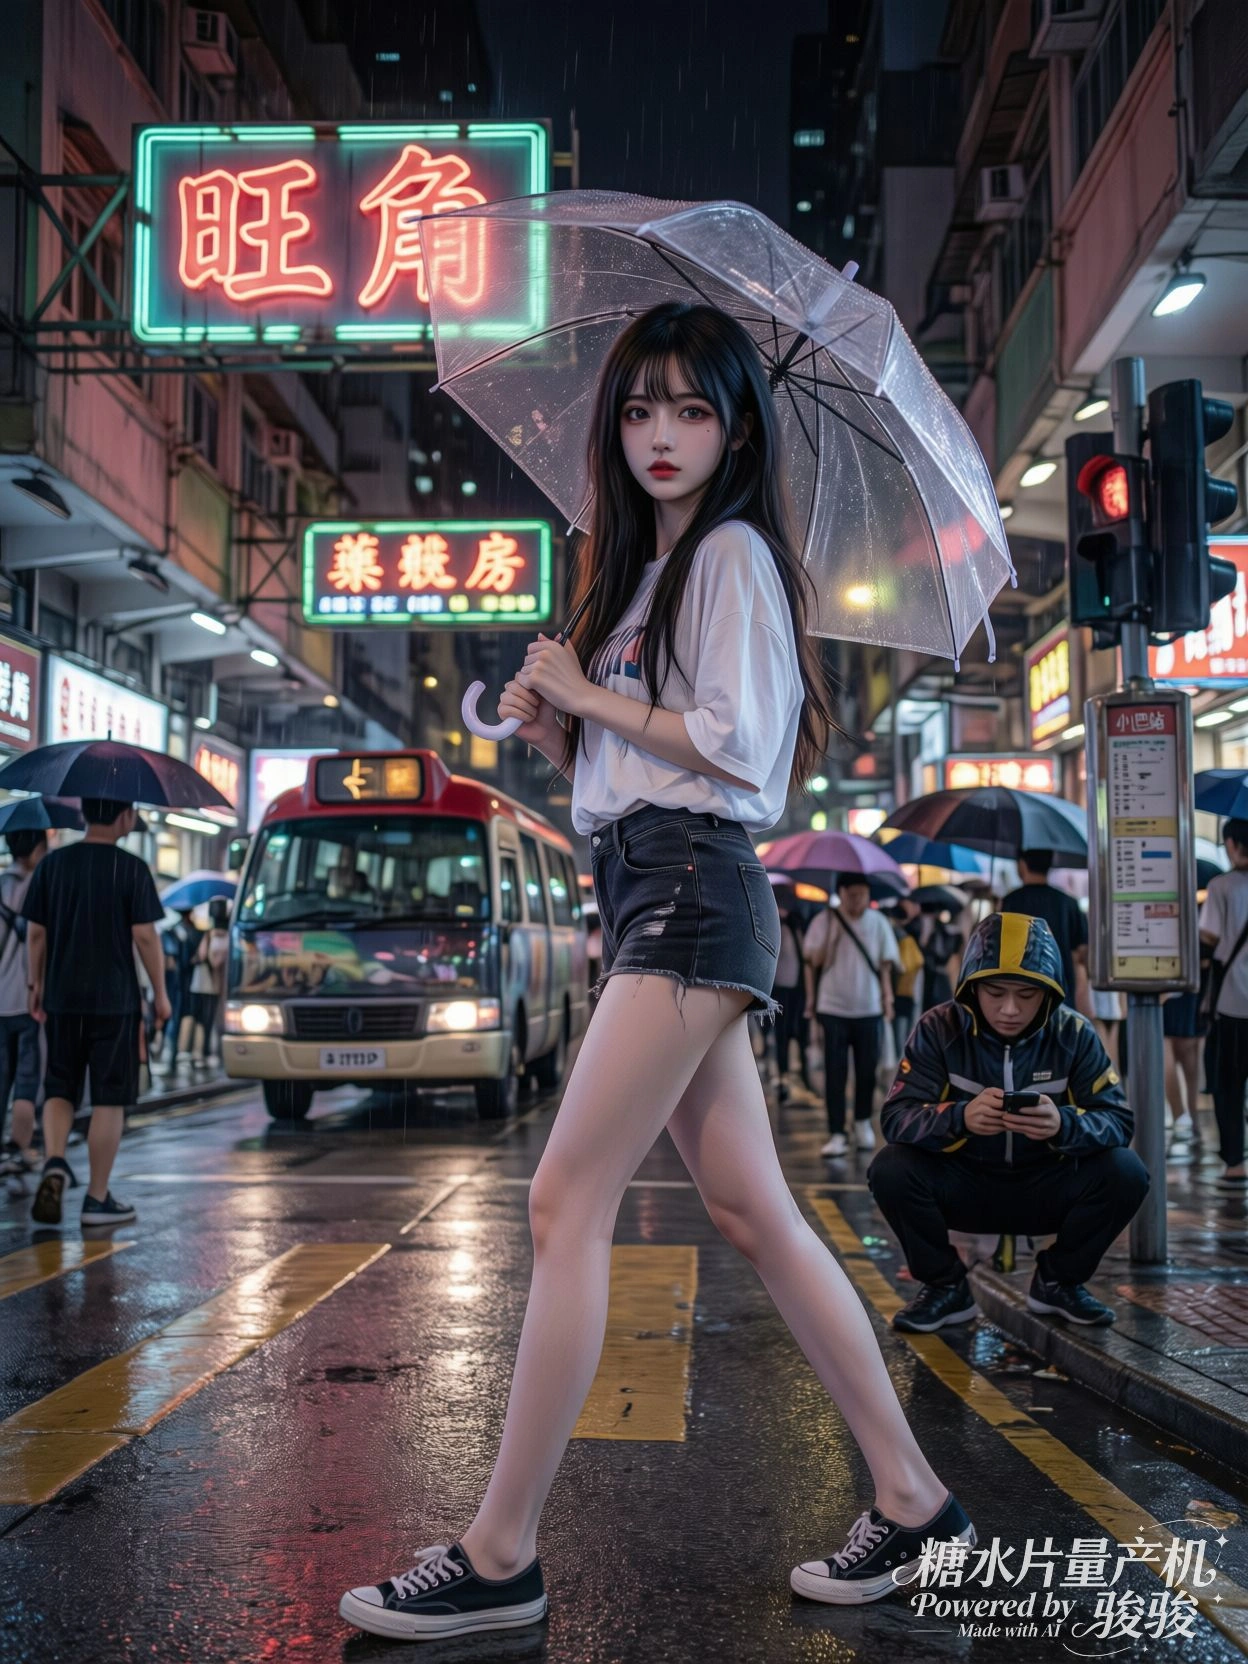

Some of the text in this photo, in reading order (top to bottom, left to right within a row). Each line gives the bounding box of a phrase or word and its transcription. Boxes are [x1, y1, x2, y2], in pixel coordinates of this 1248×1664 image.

[178, 145, 488, 308] 旺角
[1116, 711, 1166, 733] 小巴站
